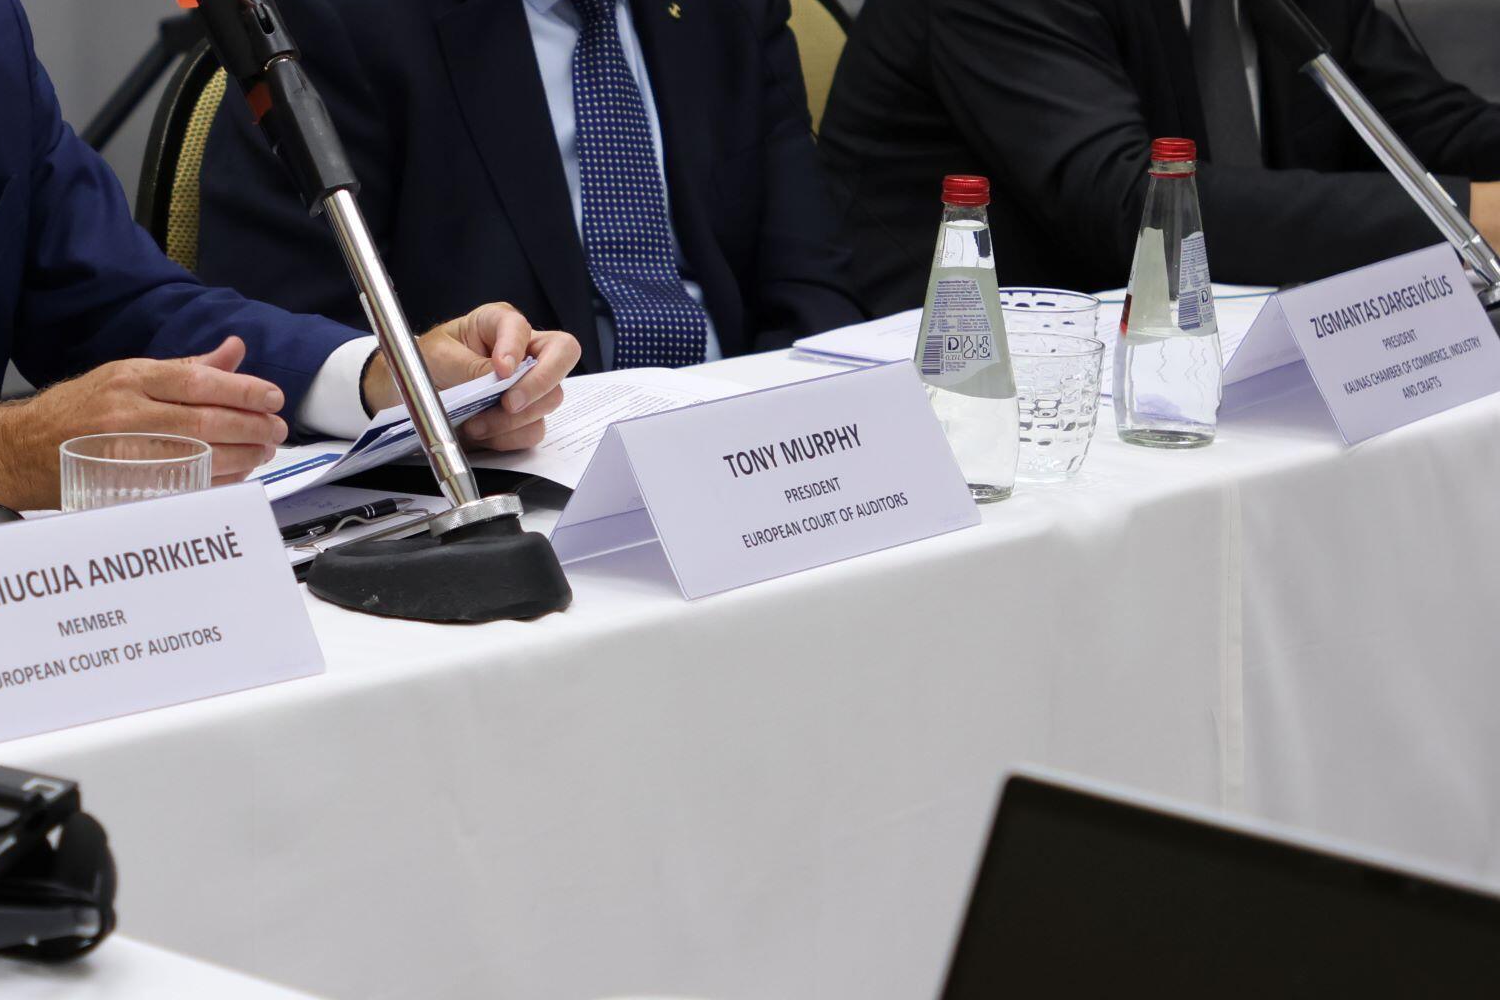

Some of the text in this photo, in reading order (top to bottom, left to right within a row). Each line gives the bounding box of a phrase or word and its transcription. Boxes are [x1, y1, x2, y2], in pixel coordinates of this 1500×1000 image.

[1309, 274, 1454, 339] ZIGMANTAS DARGEVIČIUS
[1382, 328, 1419, 351] PRESIDENT
[1342, 336, 1482, 395] KAUNAS CHAMBER OF COMMERCE, INDUSTRY
[1402, 375, 1442, 399] AND CRAFTS
[722, 423, 862, 478] TONY MURPHY
[784, 476, 842, 503] PRESIDENT
[741, 491, 909, 549] EUROPEAN COURT OF AUDITORS
[88, 525, 243, 587] ANDRIKIENĖ
[57, 608, 128, 637] MEMBER
[68, 647, 122, 673] COURT
[123, 640, 145, 661] OF
[147, 625, 223, 656] AUDITORS
